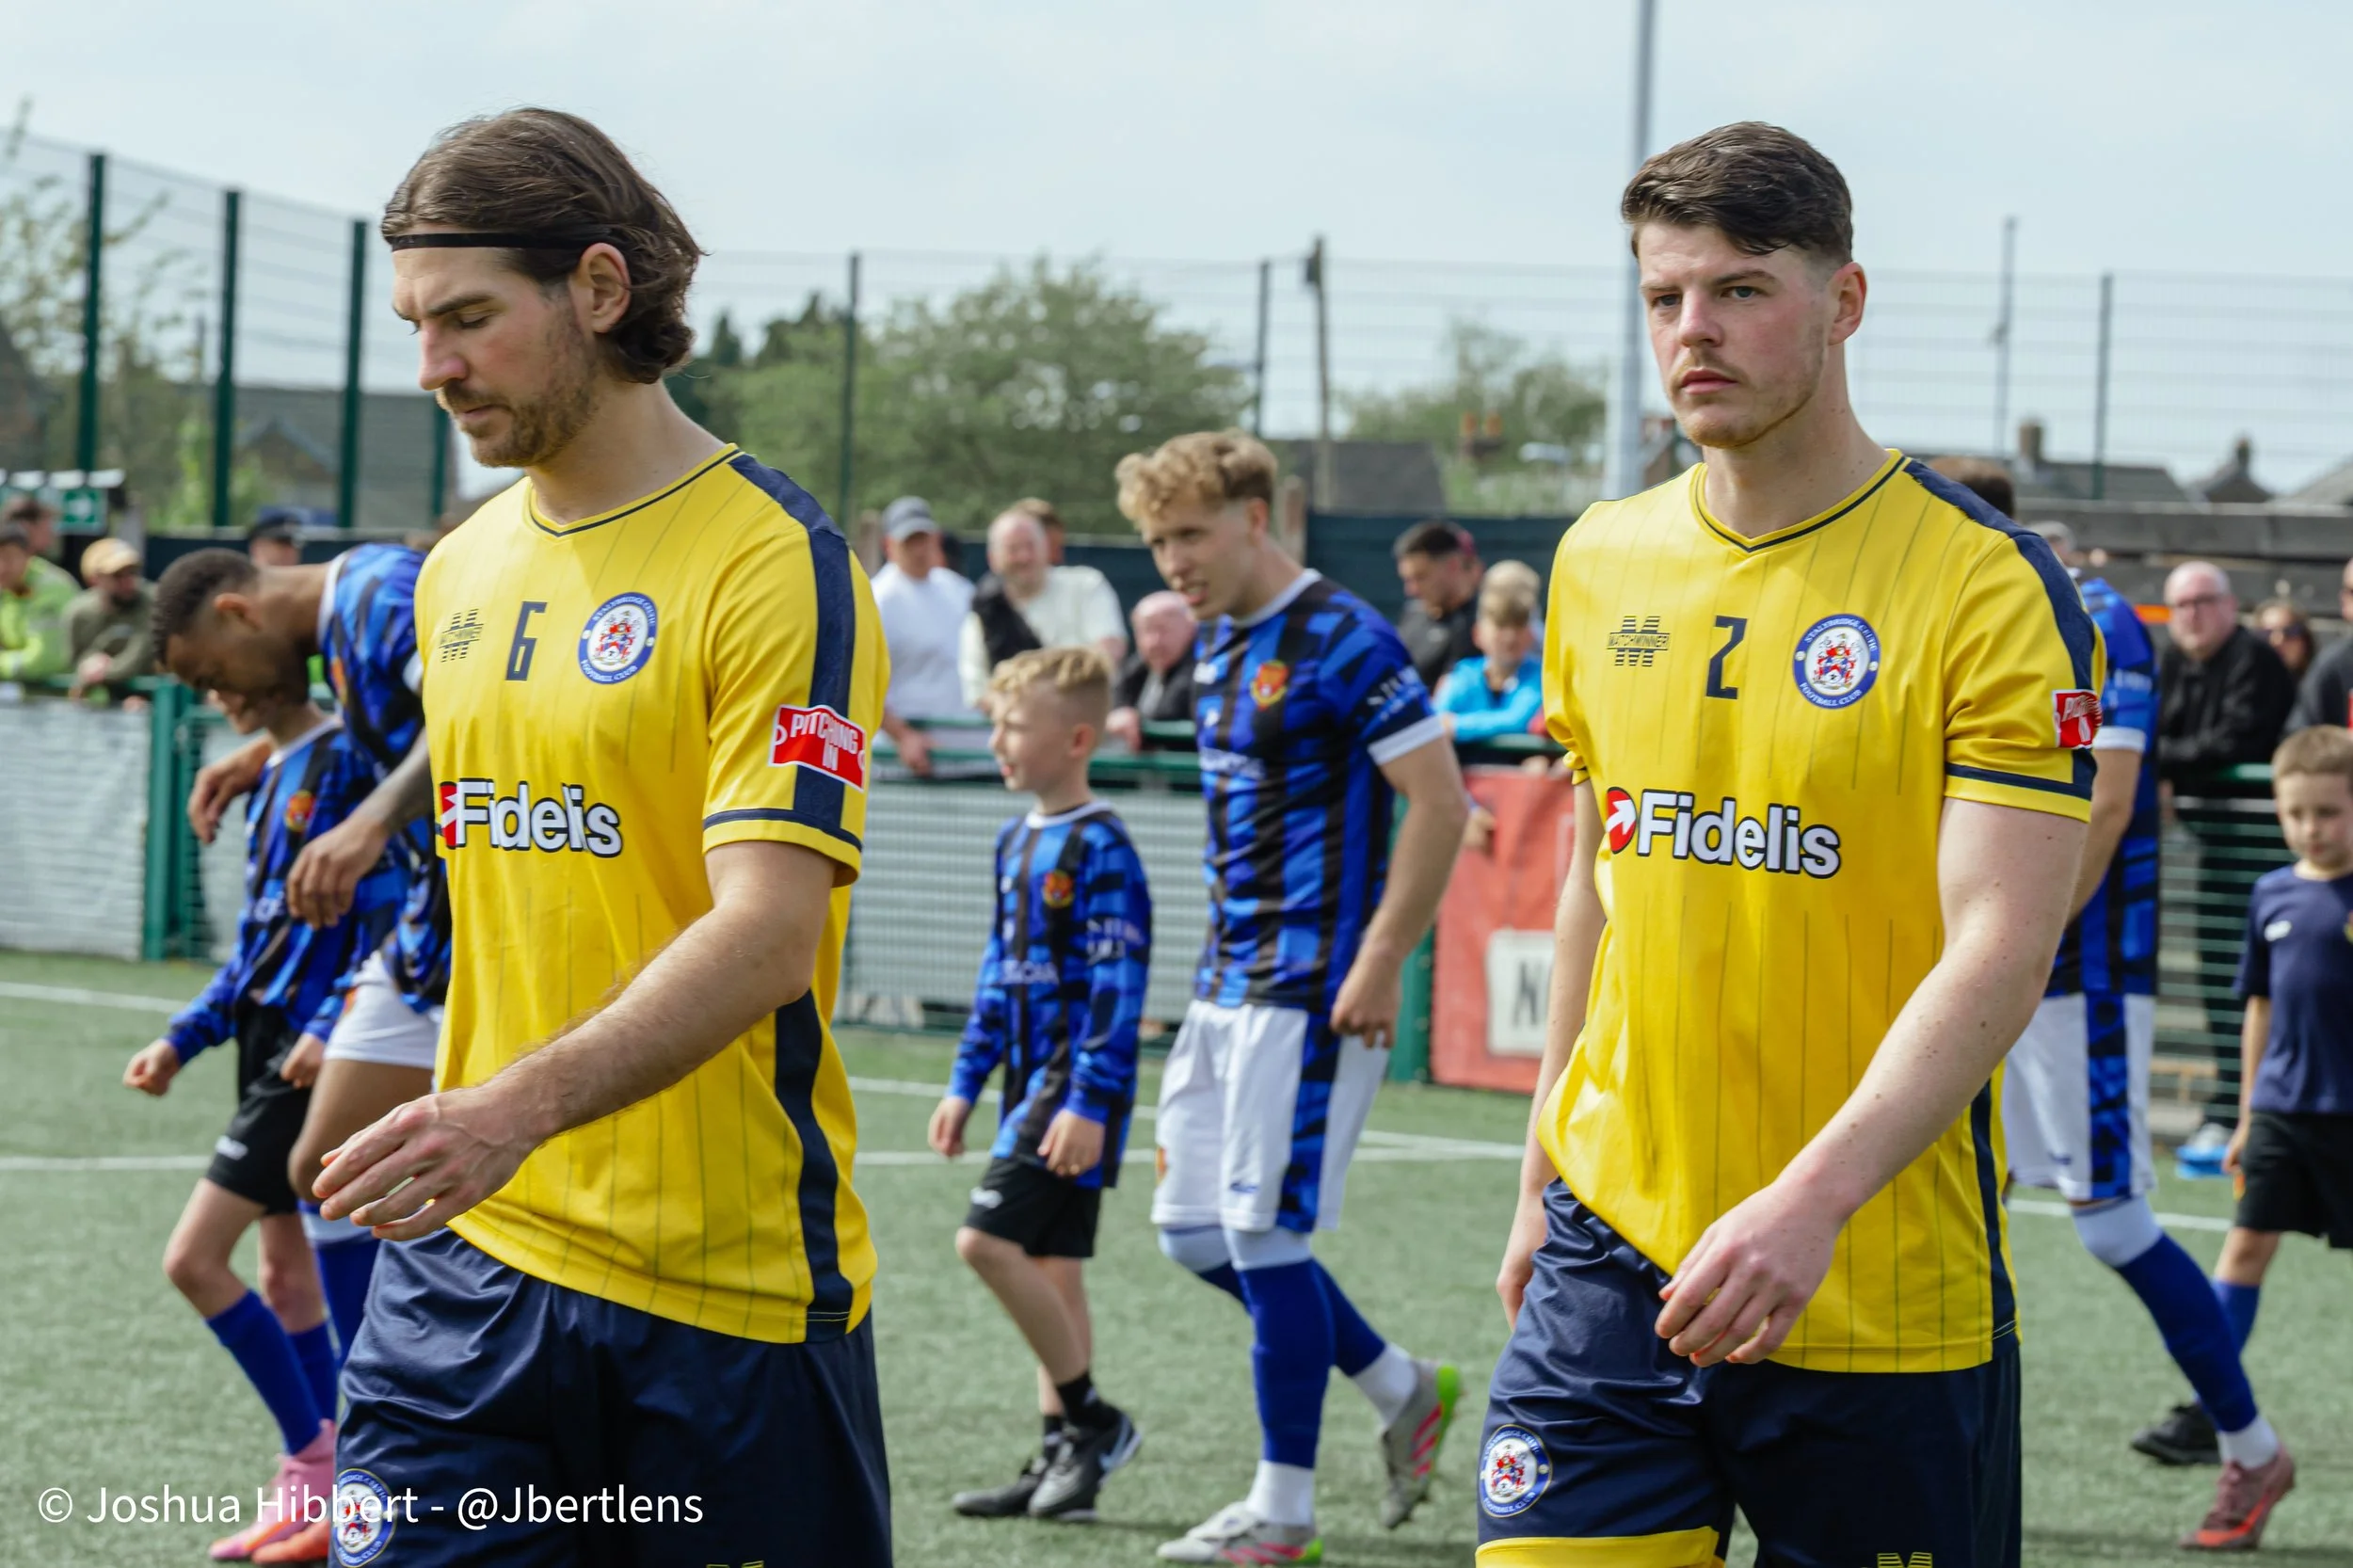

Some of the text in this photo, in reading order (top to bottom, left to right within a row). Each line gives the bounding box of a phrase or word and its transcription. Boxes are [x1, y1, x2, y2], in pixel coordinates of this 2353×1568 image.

[504, 600, 548, 681] 6
[1705, 615, 1748, 699] 2
[1804, 617, 1861, 643] STALYBRIDGE
[790, 712, 858, 754] PITCHING
[1800, 682, 1863, 706] FOOTBALL CLUB
[456, 778, 623, 857] Fidelis
[1637, 789, 1841, 879] Fidelis
